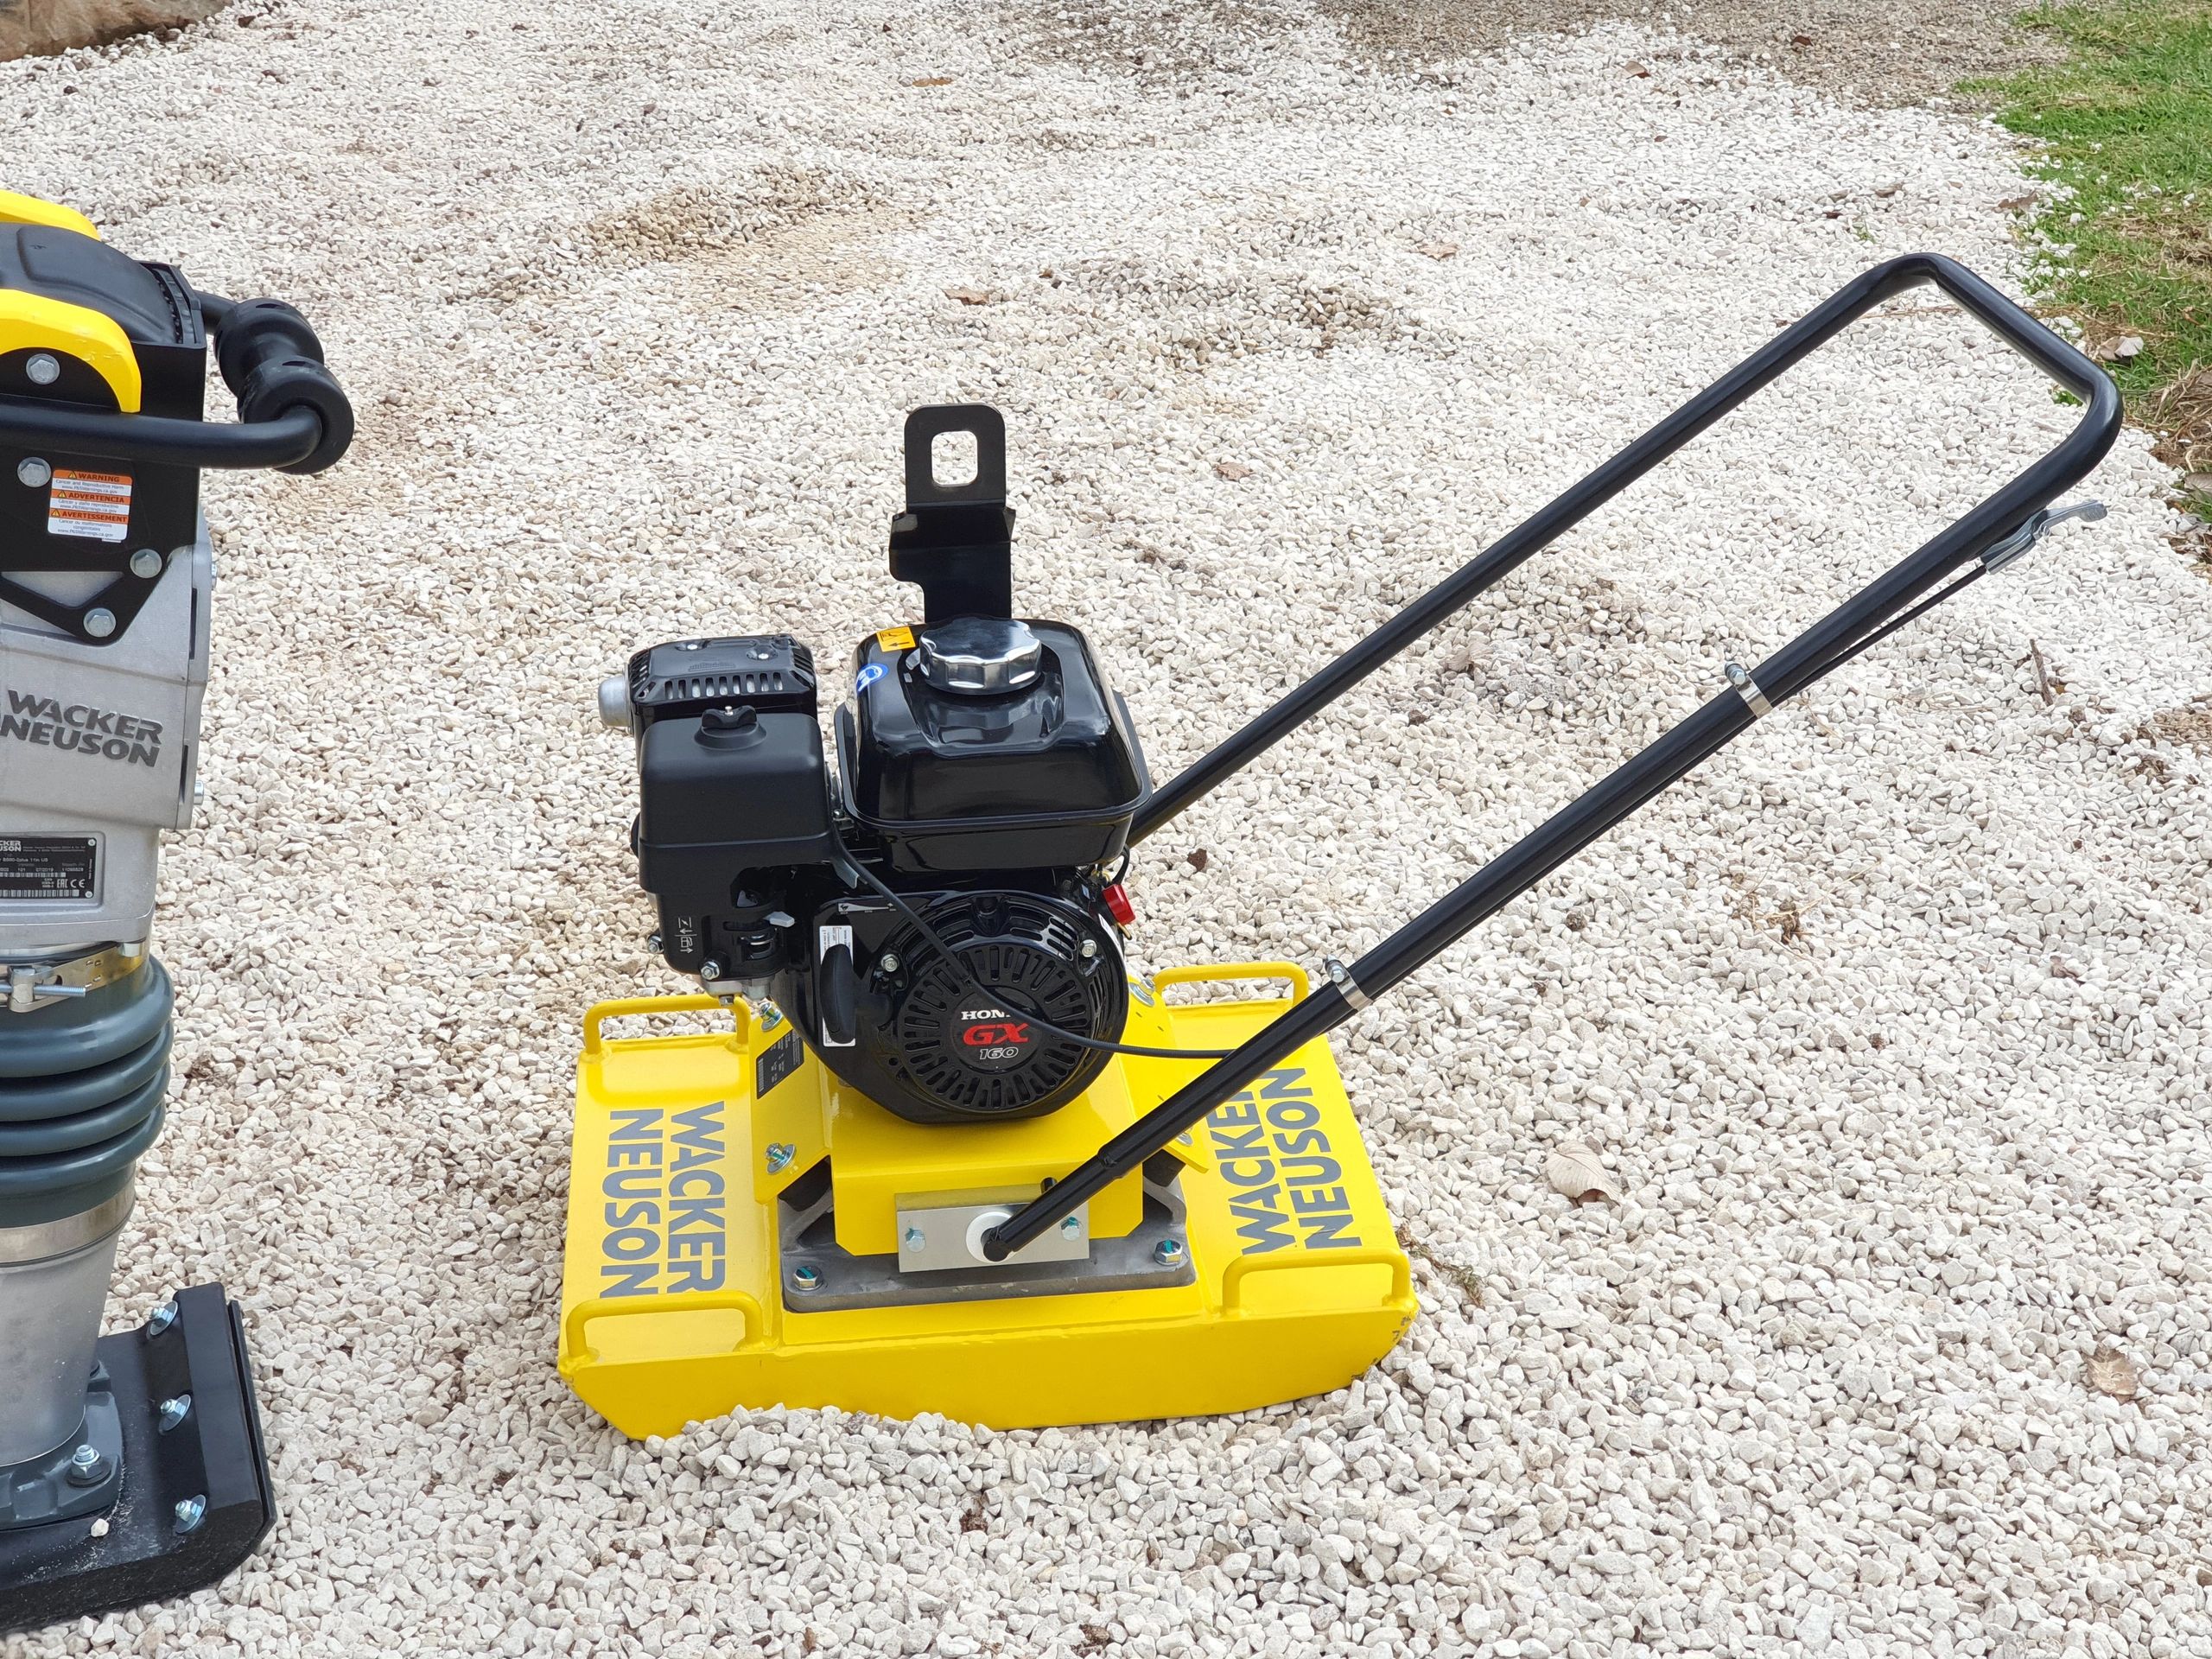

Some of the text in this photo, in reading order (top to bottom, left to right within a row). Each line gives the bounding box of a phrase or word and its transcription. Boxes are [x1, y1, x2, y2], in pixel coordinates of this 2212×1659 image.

[78, 473, 120, 483] WARNING
[67, 492, 124, 504] ADVERTENCIA
[62, 511, 127, 523] AVERTISSEMENT
[8, 690, 163, 745] WACKER
[0, 715, 161, 767] NEUSON
[961, 1009, 1011, 1020] HON
[963, 1022, 1029, 1046] GX
[979, 1046, 1019, 1060] 160
[1260, 1068, 1363, 1249] NEUSON
[600, 1109, 664, 1299] NEUSON
[666, 1101, 726, 1294] WACKER
